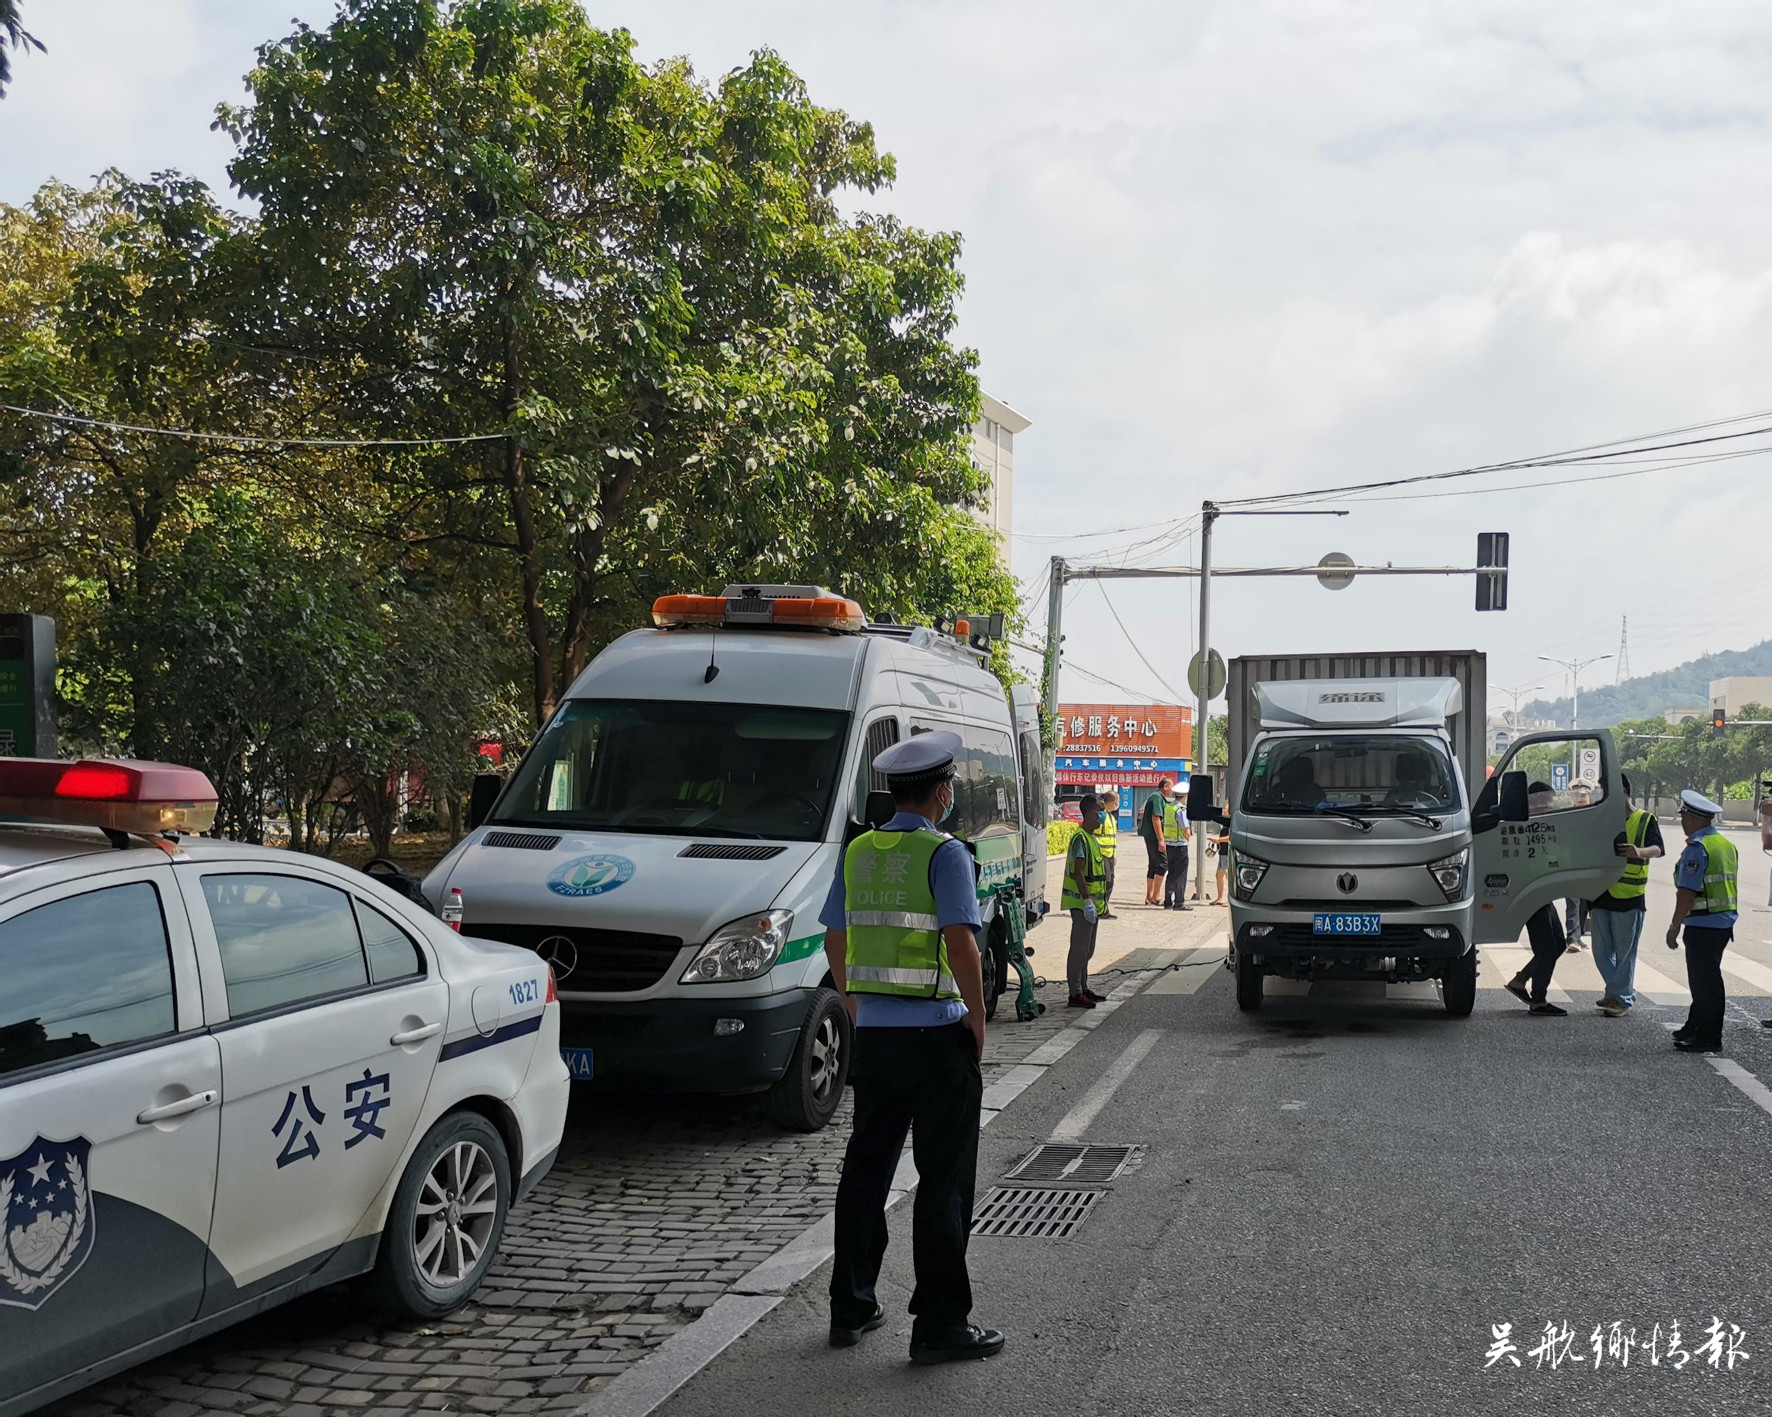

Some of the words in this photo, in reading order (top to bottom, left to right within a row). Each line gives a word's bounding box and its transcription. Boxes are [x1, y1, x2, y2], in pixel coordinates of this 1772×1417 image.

[1110, 744, 1159, 753] 13960949571
[855, 850, 911, 884] 警察
[850, 890, 907, 905] POLICE
[508, 979, 539, 1005] 1827
[561, 1053, 591, 1075] KA
[271, 1068, 391, 1170] 公安
